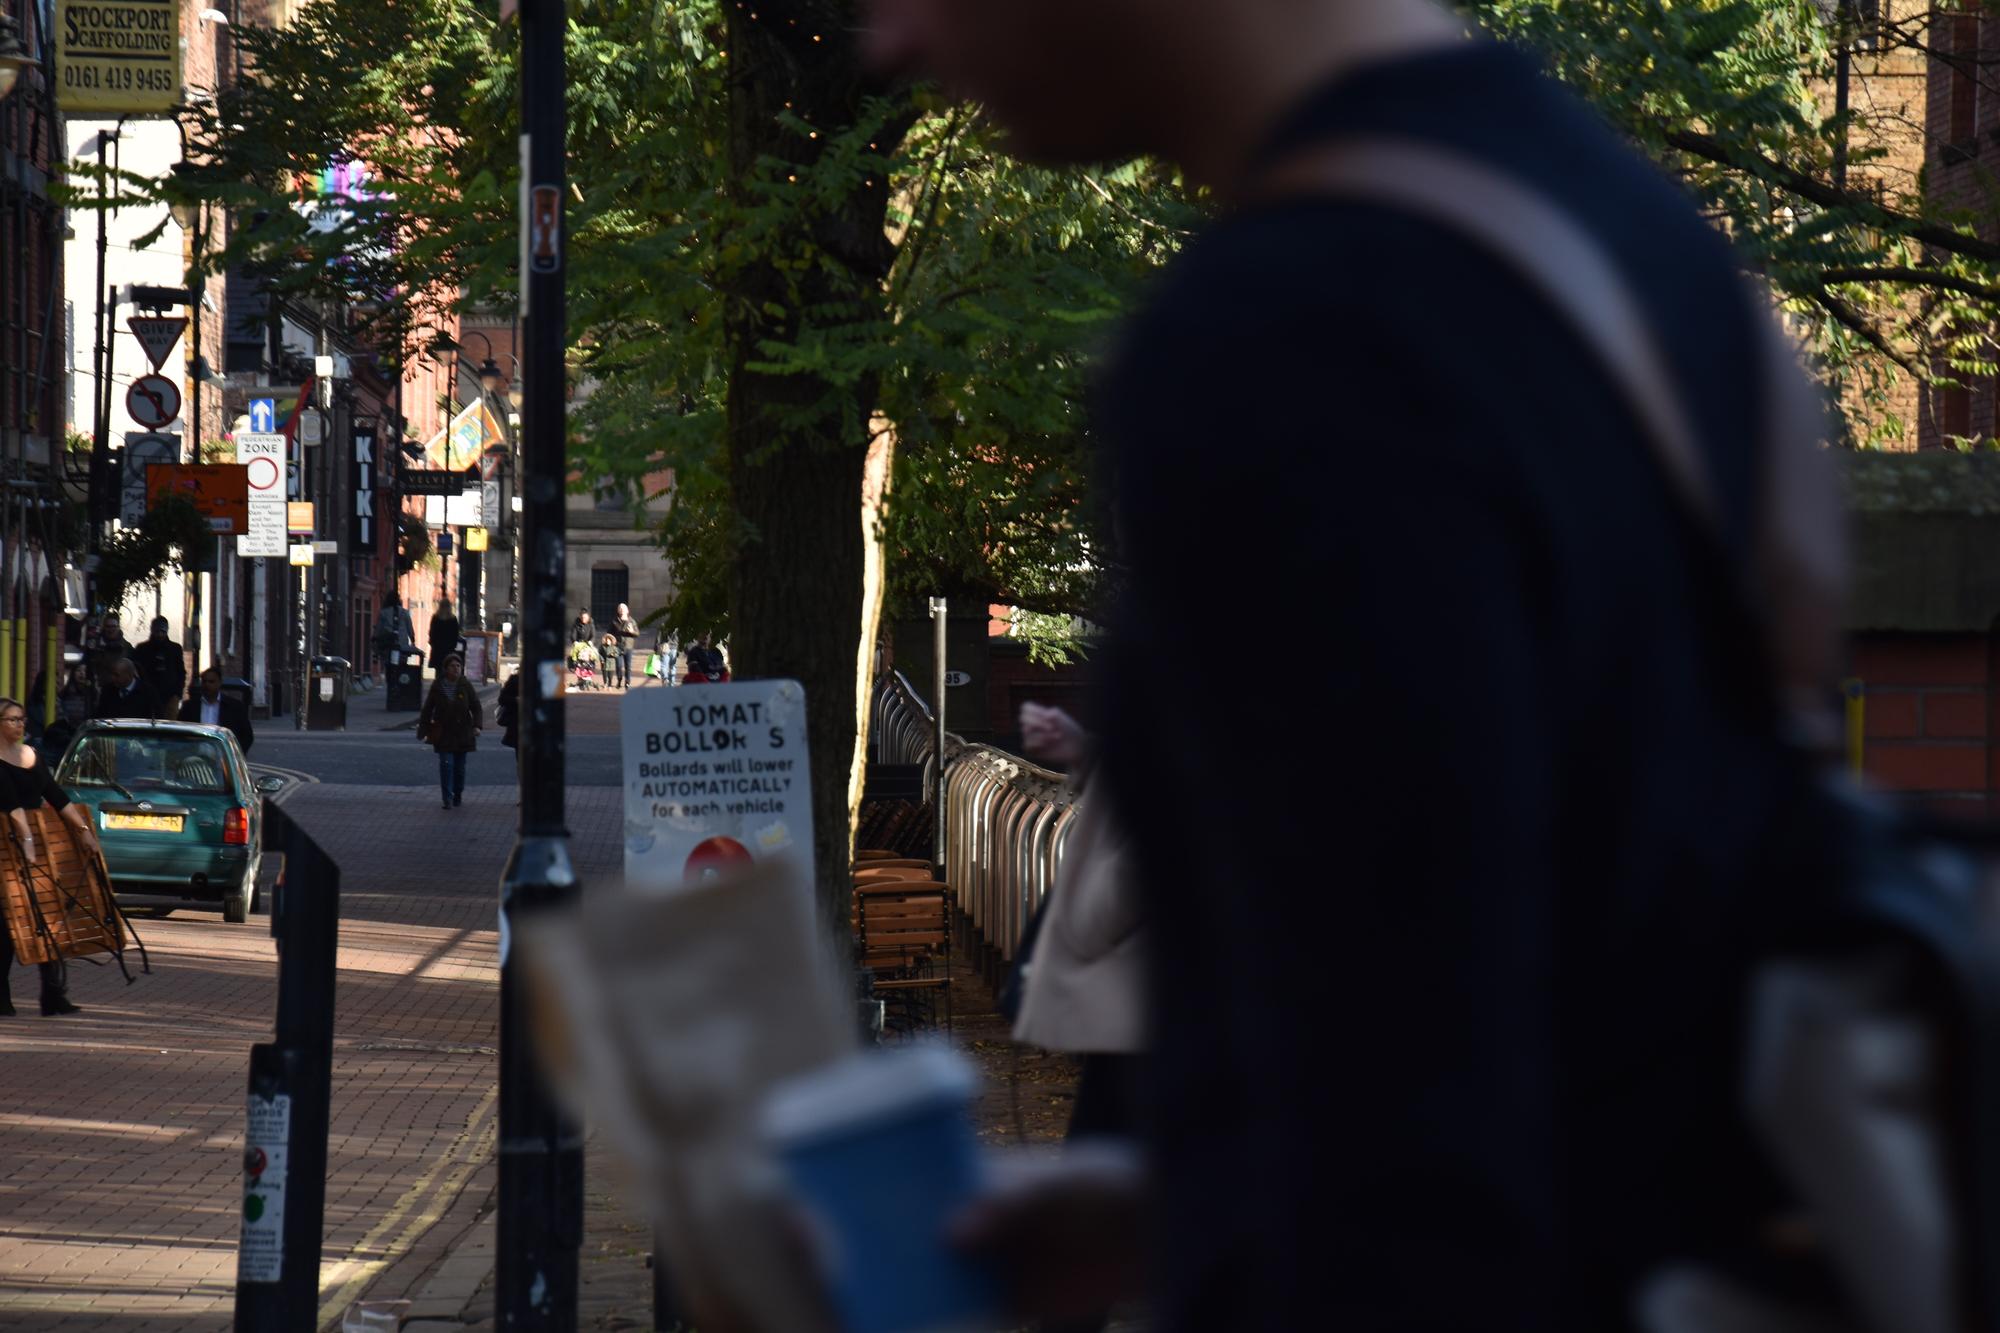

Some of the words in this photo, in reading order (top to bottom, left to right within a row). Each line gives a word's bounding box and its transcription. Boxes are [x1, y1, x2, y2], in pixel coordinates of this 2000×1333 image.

[64, 6, 171, 33] STOCKPORT
[64, 29, 171, 50] SCAFFOLDING
[65, 65, 100, 88] 0161
[105, 66, 132, 89] 419
[136, 68, 172, 91] 9455
[140, 323, 176, 334] GIVE
[147, 335, 169, 345] WAY
[244, 444, 278, 453] ZONE
[355, 436, 373, 544] KIKI
[639, 761, 708, 778] Bollards
[713, 759, 743, 775] will
[748, 758, 794, 773] lower
[641, 778, 791, 798] AUTOMATICALLY
[651, 803, 675, 818] for
[681, 800, 720, 817] each
[726, 798, 784, 814] vehicle
